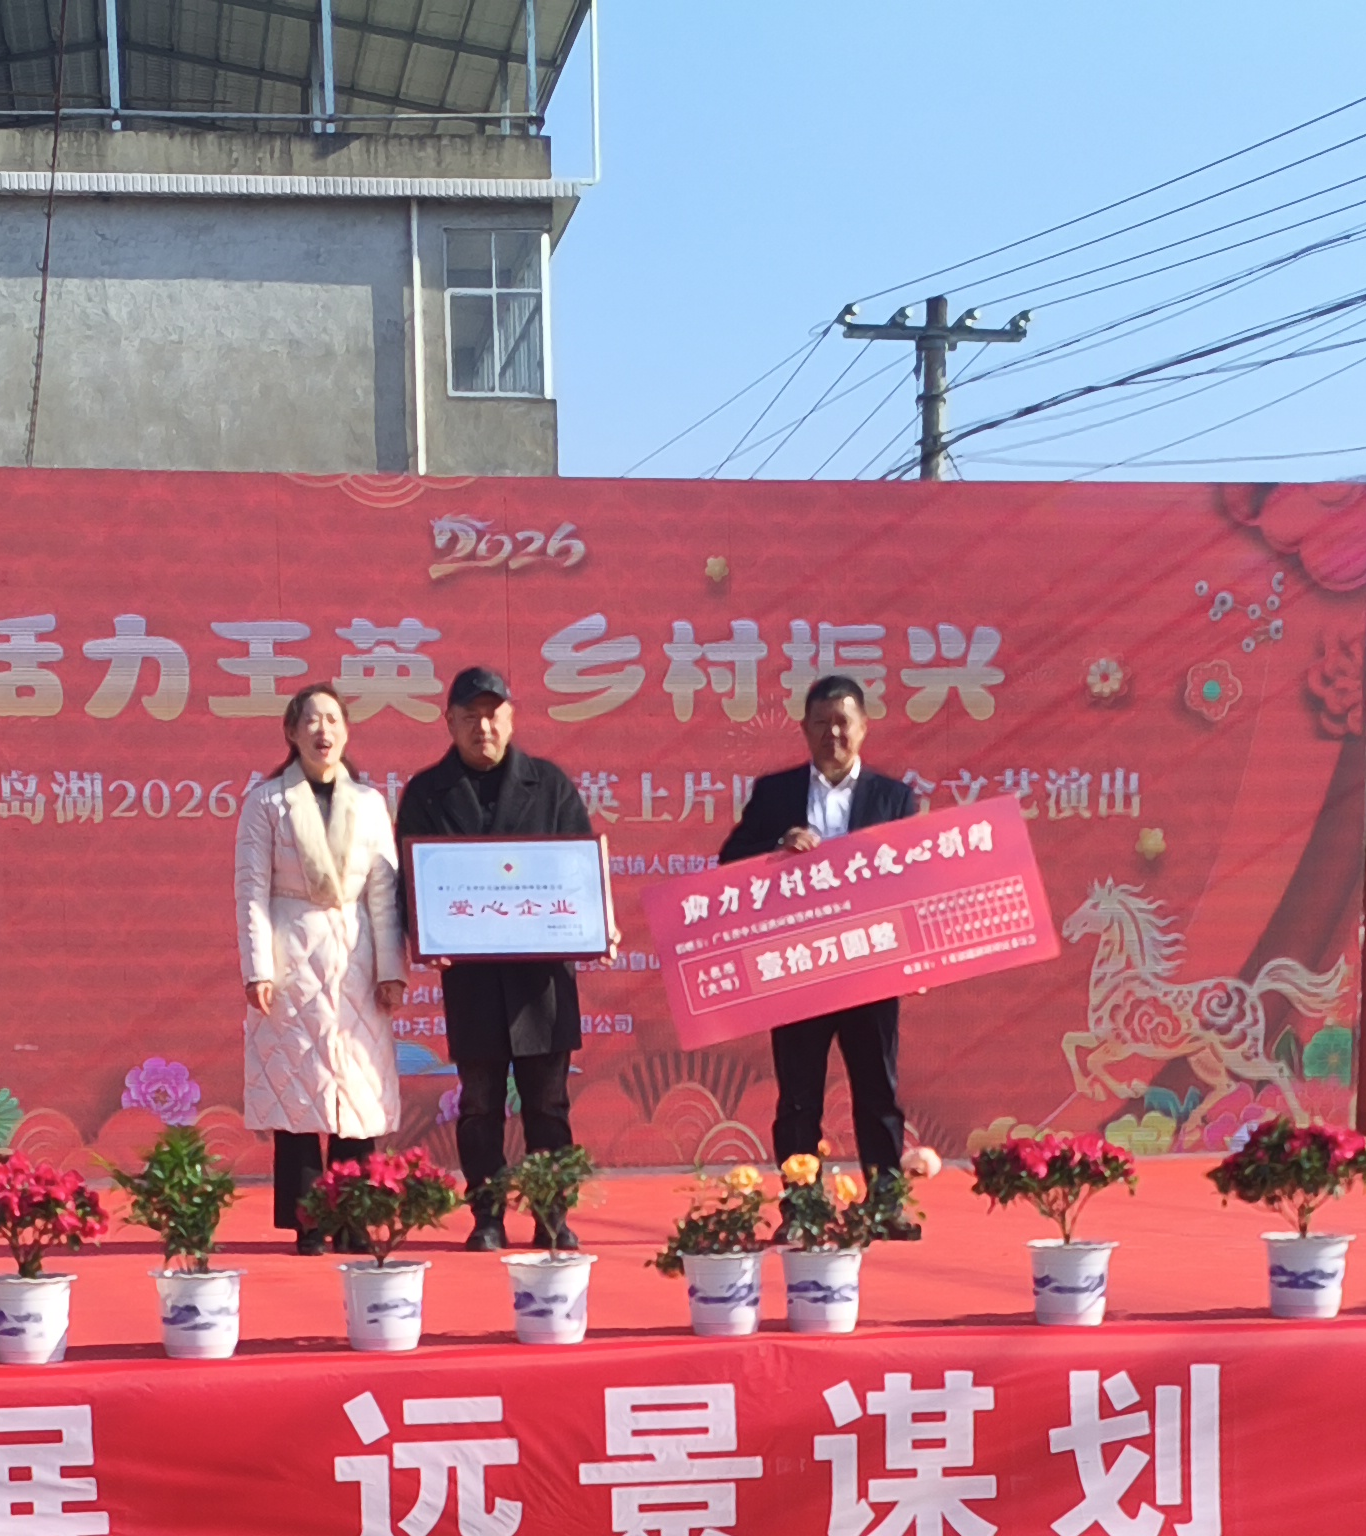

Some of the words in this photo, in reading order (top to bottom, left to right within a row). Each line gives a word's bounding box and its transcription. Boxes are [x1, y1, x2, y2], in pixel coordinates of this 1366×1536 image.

[429, 514, 586, 580] 2026
[539, 612, 1006, 723] 乡村振兴
